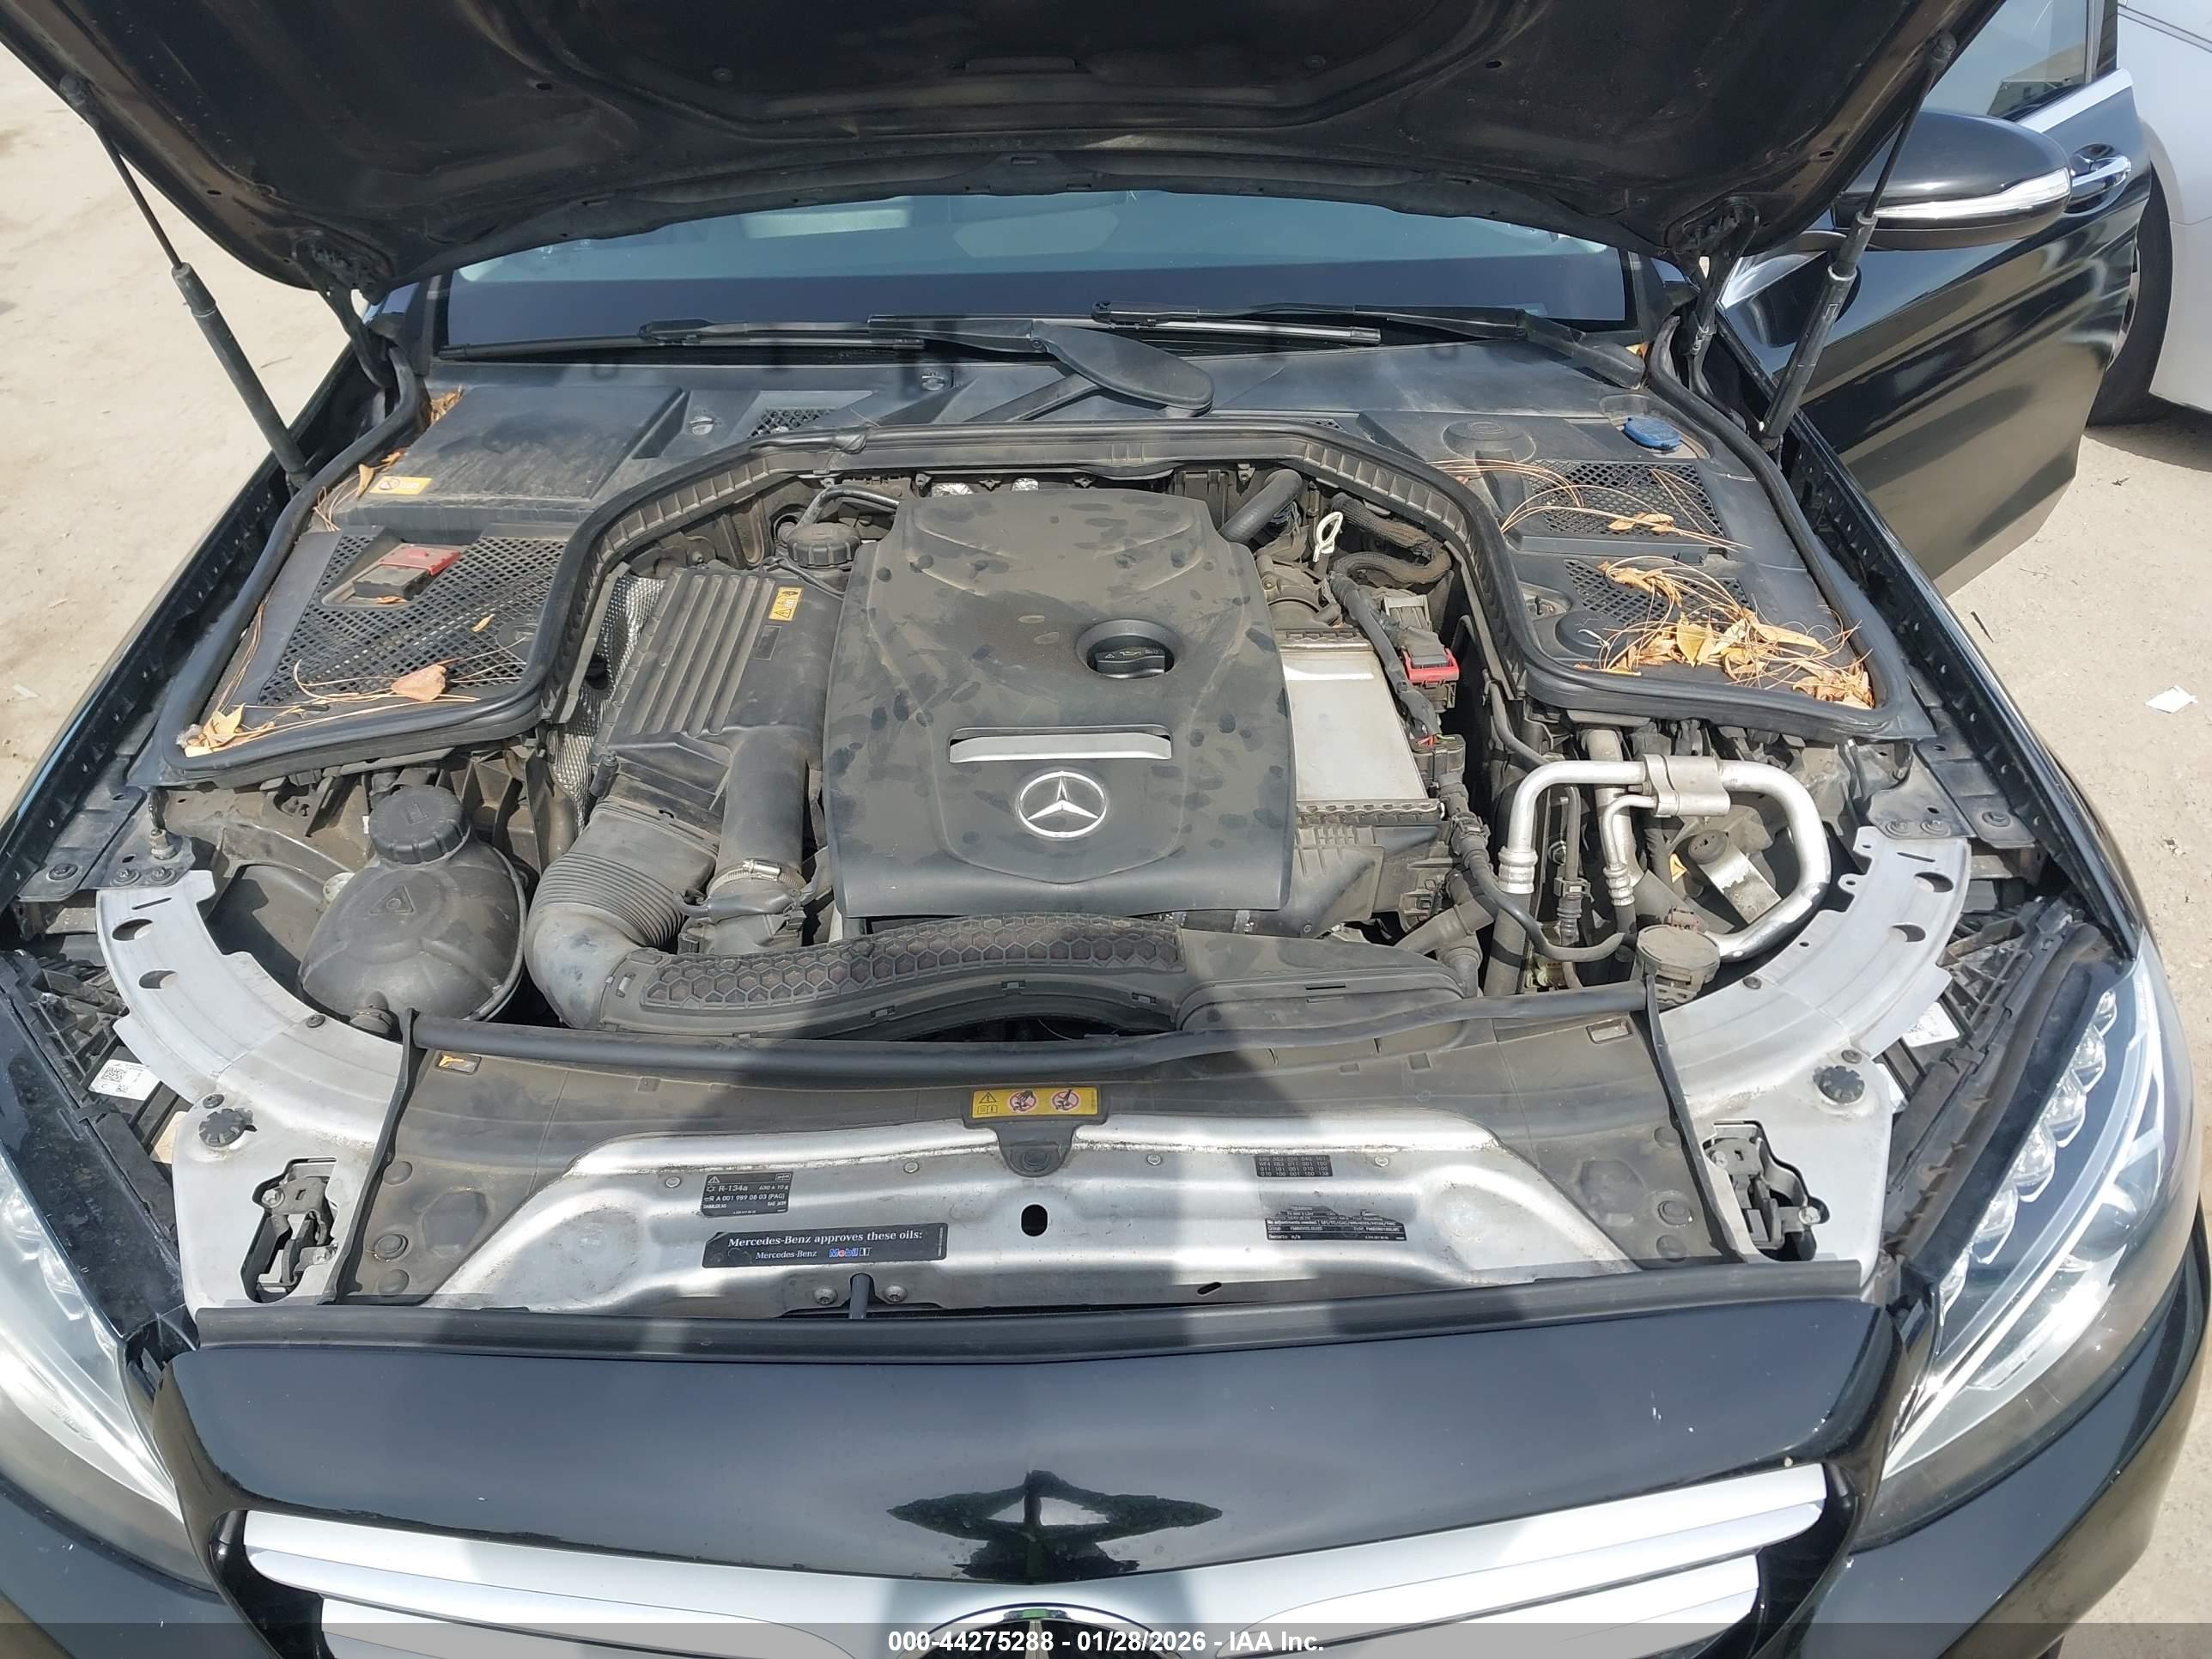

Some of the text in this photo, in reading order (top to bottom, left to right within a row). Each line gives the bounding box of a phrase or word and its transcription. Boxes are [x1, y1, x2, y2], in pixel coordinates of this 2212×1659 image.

[728, 1230, 923, 1247] Mercedes-Benz approves these oils:
[756, 1250, 817, 1260] Mercedes-Benz
[829, 1248, 858, 1258] Mobil
